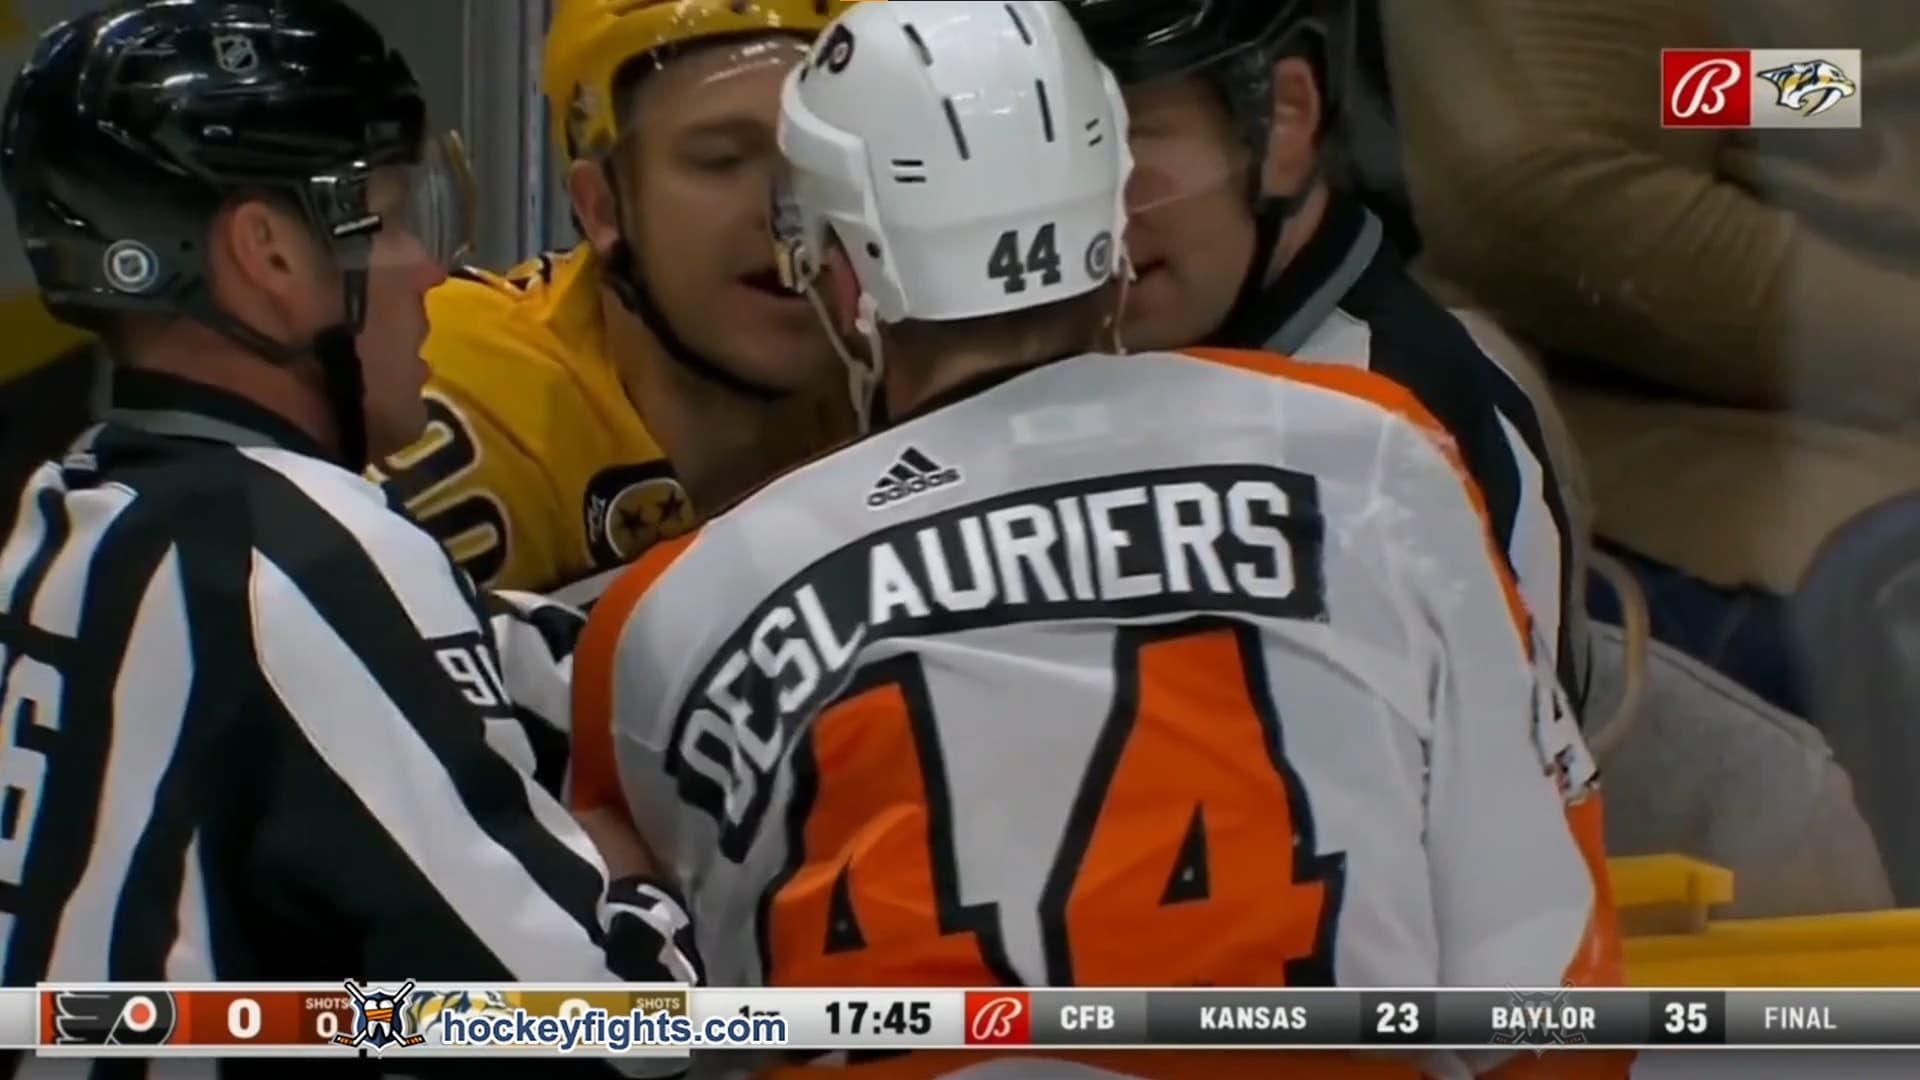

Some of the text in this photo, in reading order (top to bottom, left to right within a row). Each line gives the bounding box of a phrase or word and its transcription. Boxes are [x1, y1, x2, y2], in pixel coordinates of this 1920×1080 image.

[987, 222, 1061, 294] 44
[868, 468, 961, 506] adidas
[680, 481, 1295, 826] DESLAURIERS
[758, 614, 1347, 986] 44
